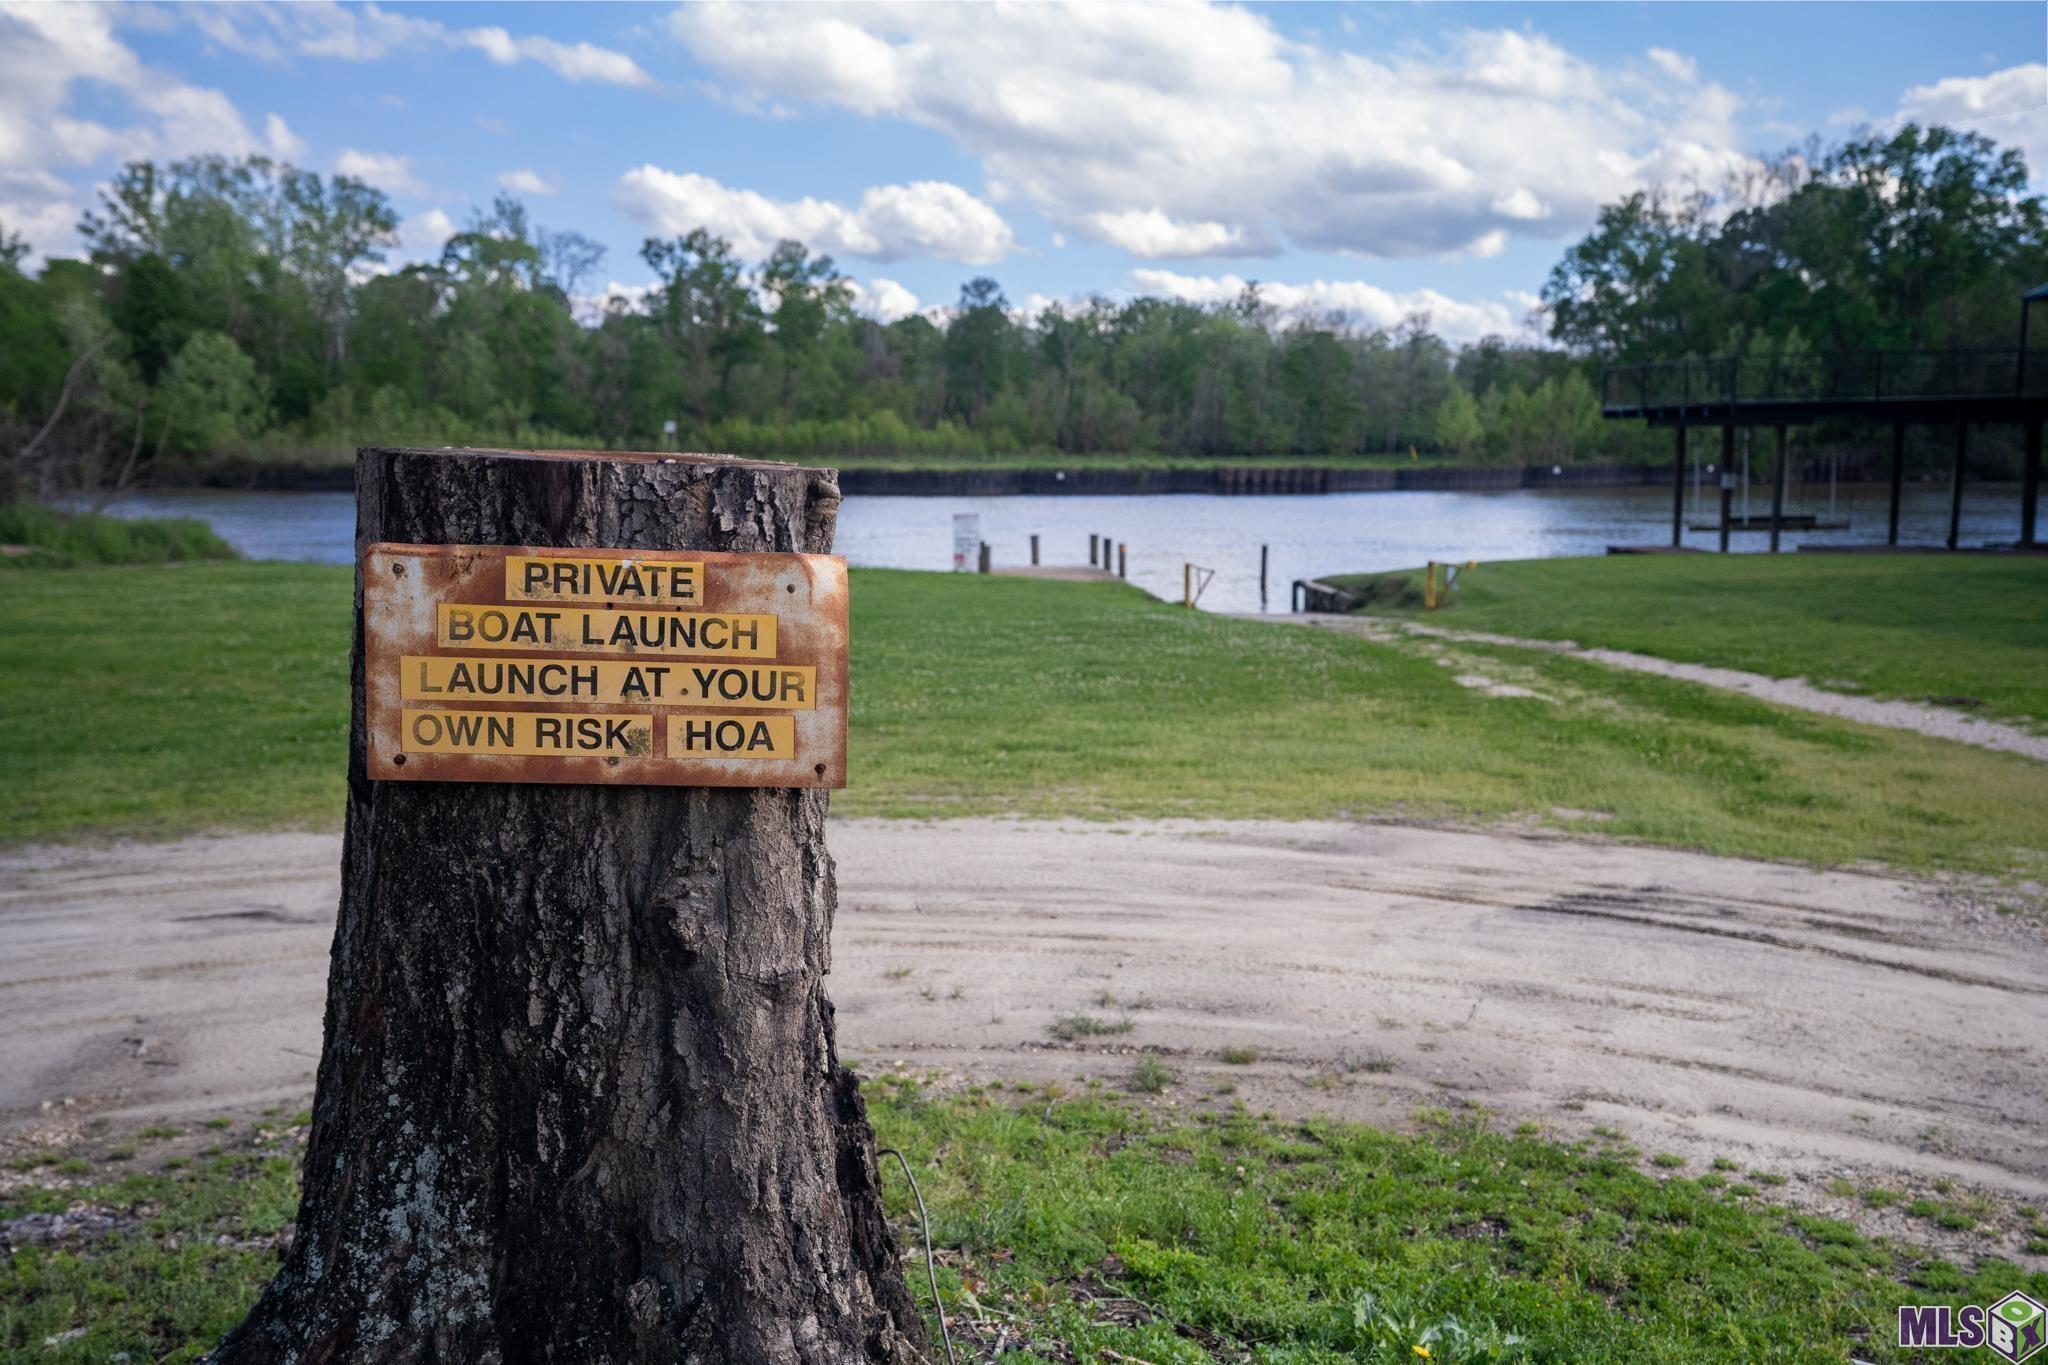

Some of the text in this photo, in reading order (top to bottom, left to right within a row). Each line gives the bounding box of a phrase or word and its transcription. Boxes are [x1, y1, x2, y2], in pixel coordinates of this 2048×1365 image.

[524, 562, 694, 598] PRIVATE
[448, 609, 758, 650] BOAT LAUNCH
[420, 662, 805, 702] LAUNCH AT YOUR
[412, 715, 774, 752] OWN RISK HOA
